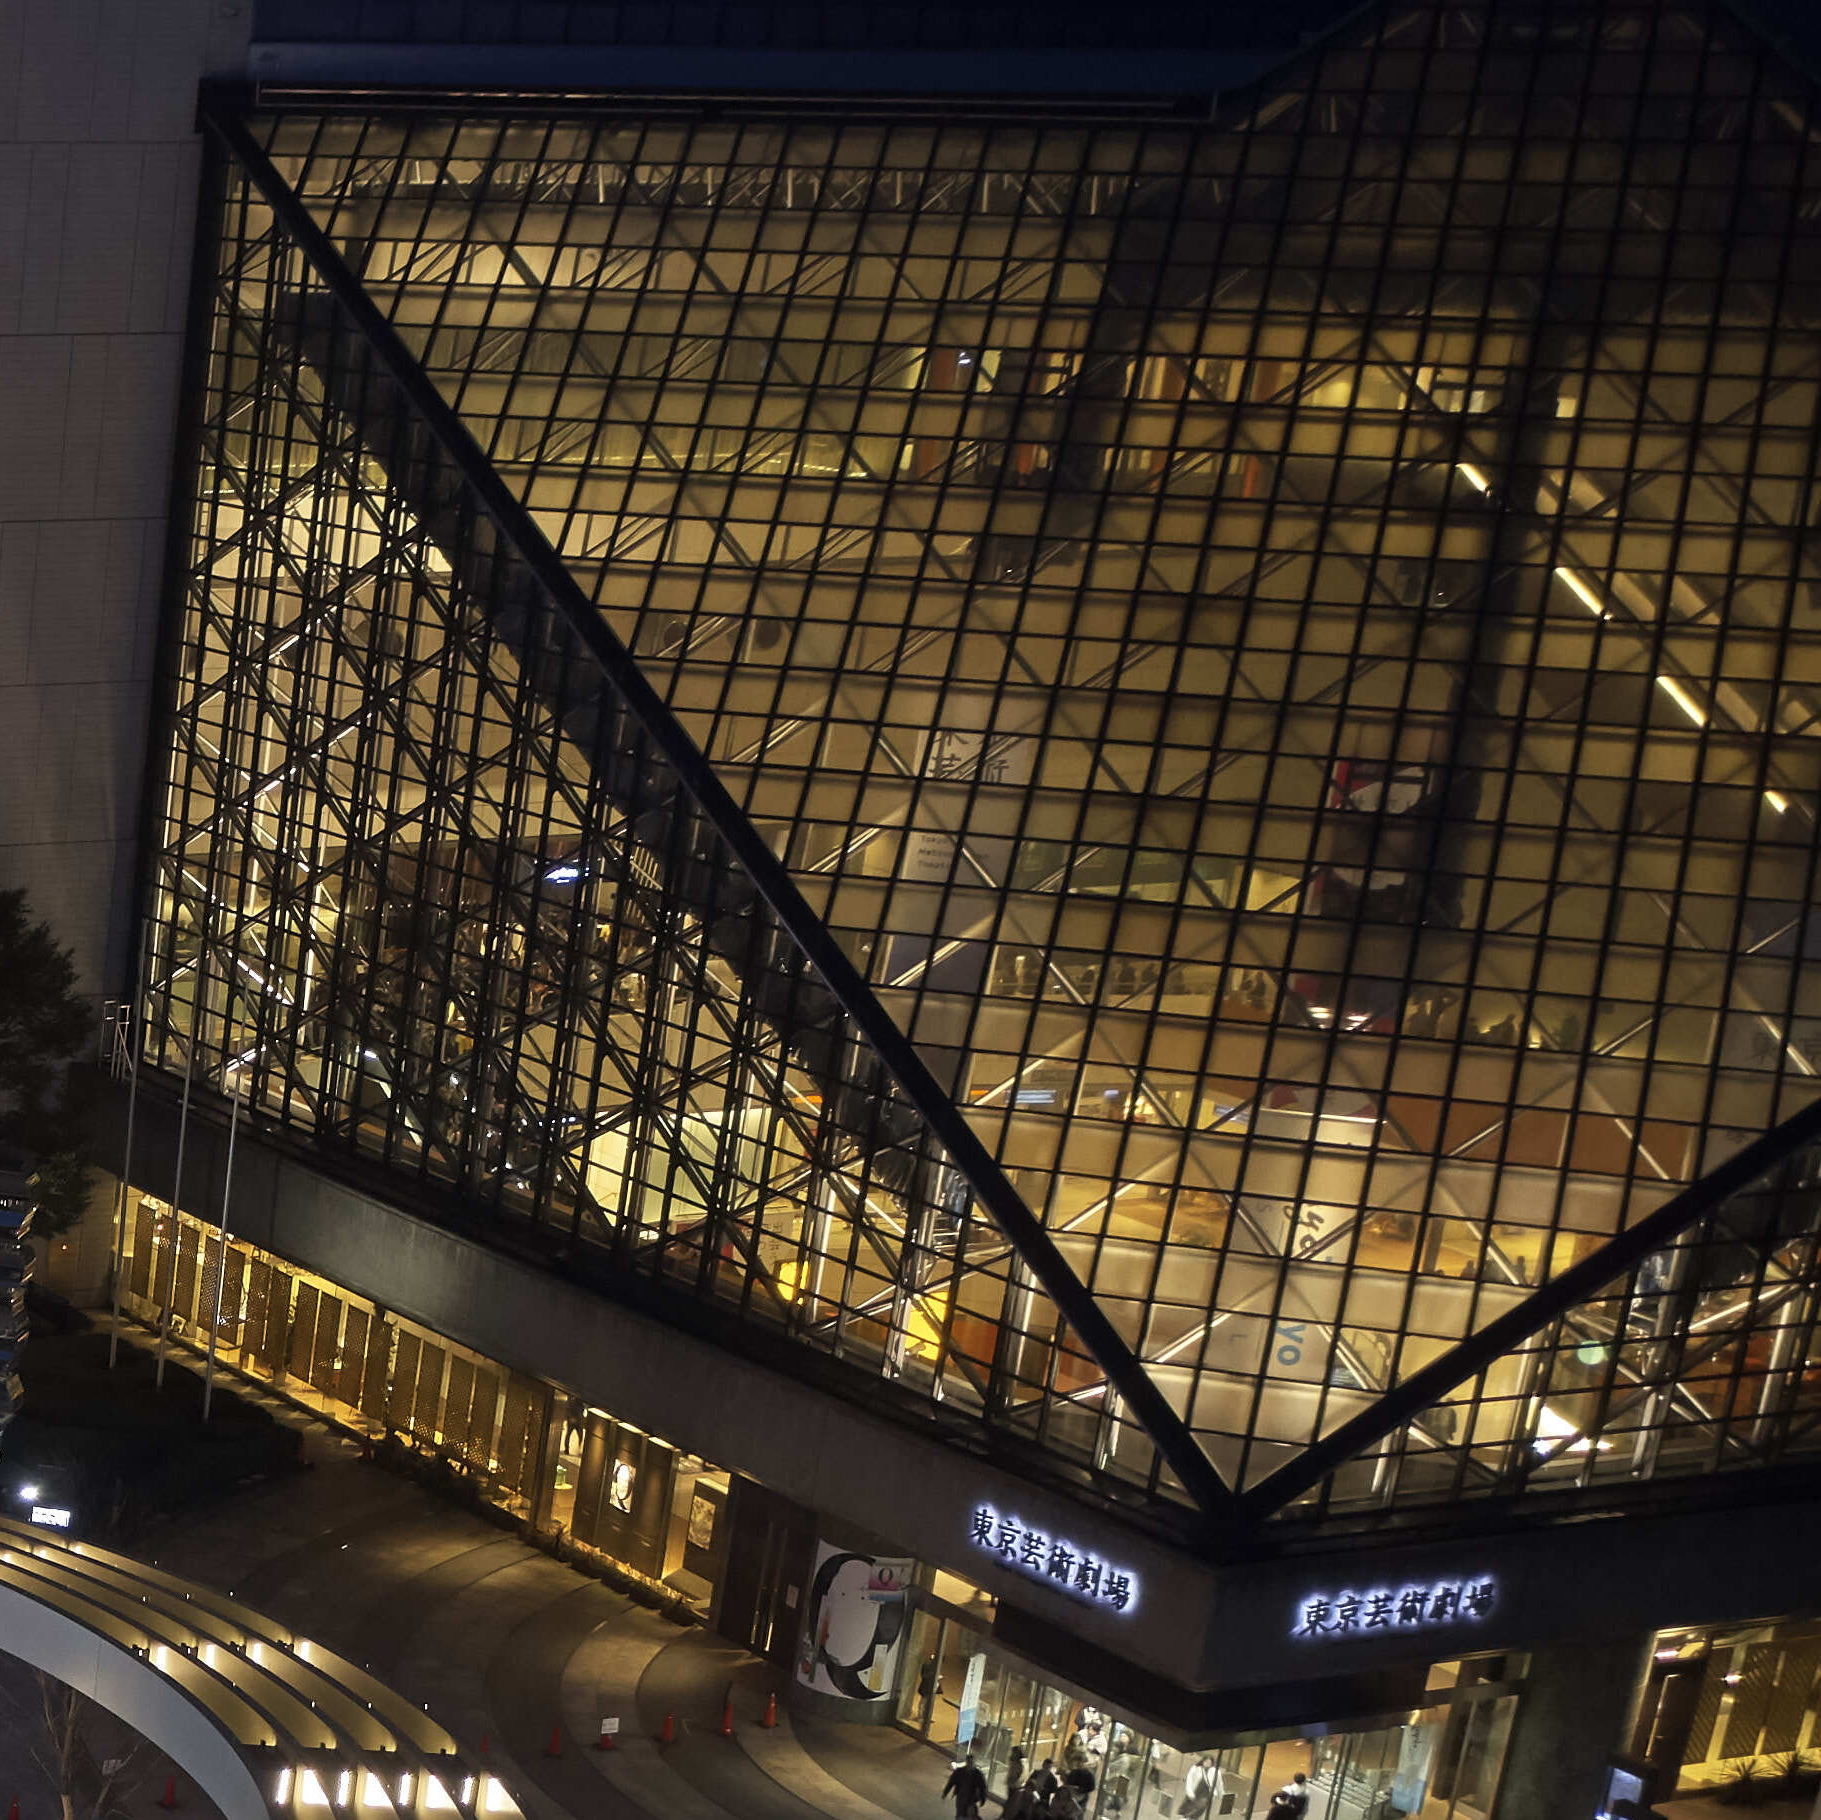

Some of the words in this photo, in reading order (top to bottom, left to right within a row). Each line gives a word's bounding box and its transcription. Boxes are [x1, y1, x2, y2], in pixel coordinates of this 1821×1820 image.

[969, 1508, 1131, 1611] 東京芸術劇場
[1298, 1582, 1495, 1637] 東京芸術劇場
